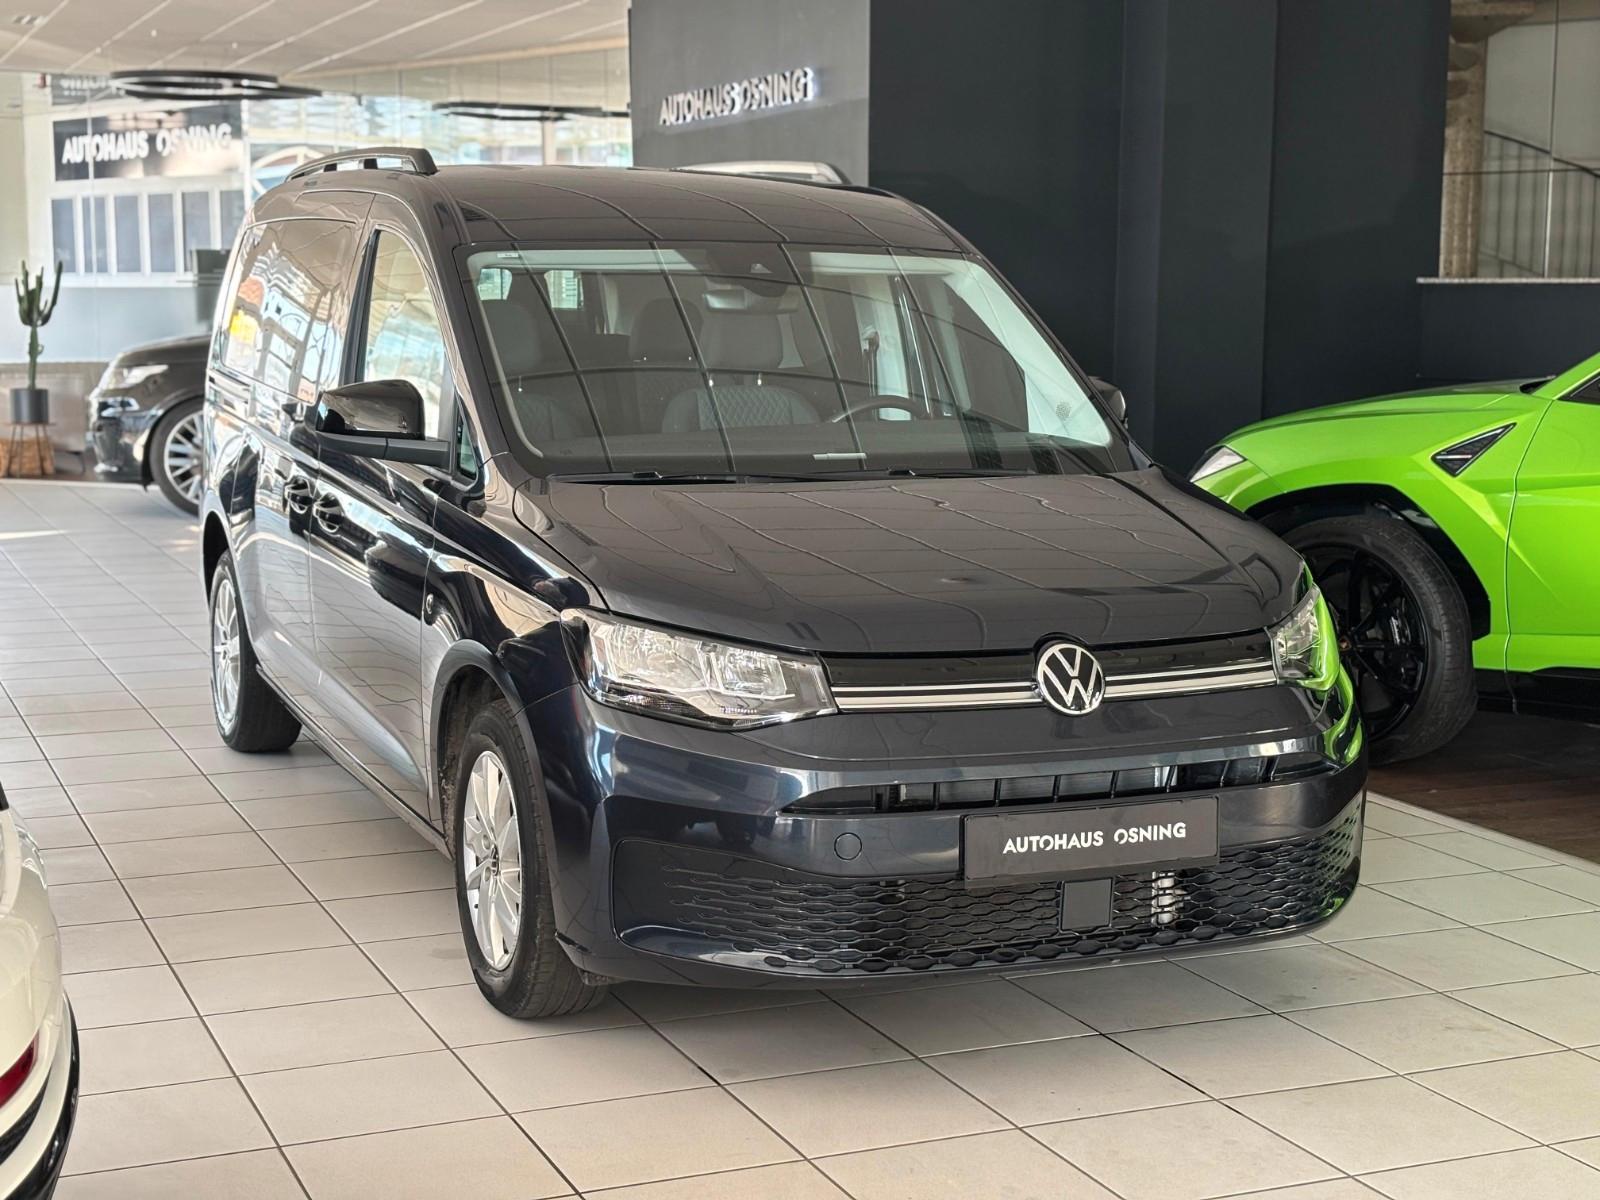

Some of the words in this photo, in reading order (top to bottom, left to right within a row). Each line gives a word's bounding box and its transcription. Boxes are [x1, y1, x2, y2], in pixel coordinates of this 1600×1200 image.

[659, 83, 738, 126] AUTOHAUS
[740, 67, 813, 110] OSNING
[62, 133, 149, 164] AUTOHAUS
[155, 123, 232, 156] OSNING
[1003, 831, 1104, 855] AUTOHAUS
[1114, 822, 1187, 845] OSNING
